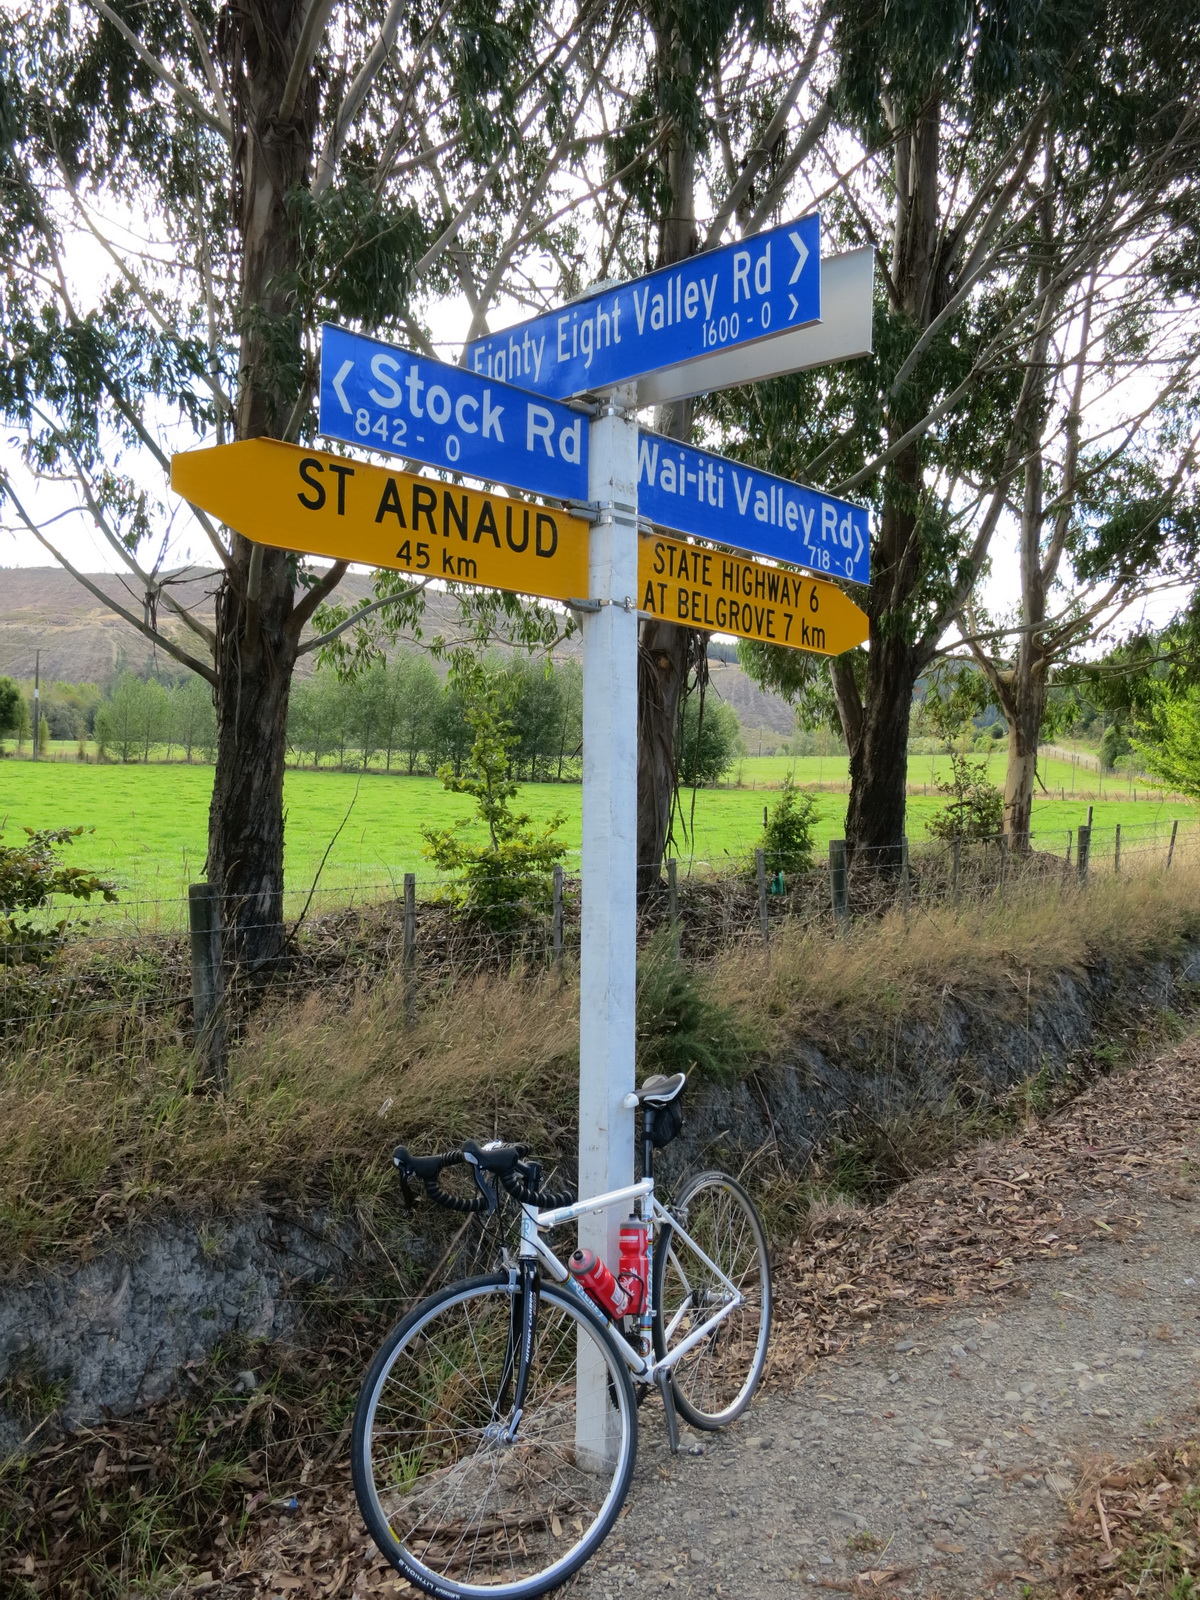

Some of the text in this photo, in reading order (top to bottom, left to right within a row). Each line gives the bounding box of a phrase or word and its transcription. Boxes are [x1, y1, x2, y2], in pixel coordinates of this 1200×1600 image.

[474, 241, 771, 383] Eighty Eight Valley Rd
[703, 312, 740, 348] 1600
[355, 408, 407, 447] 842
[368, 354, 581, 465] Stock Rd
[297, 458, 558, 558] ST ARNAUD
[638, 440, 852, 549] Wai-iti Valley Rd
[396, 540, 477, 578] 45 km
[653, 542, 819, 613] STATE HIGHWAY 6
[808, 545, 830, 570] 718
[643, 580, 826, 650] AT BELGROVE 7 km
